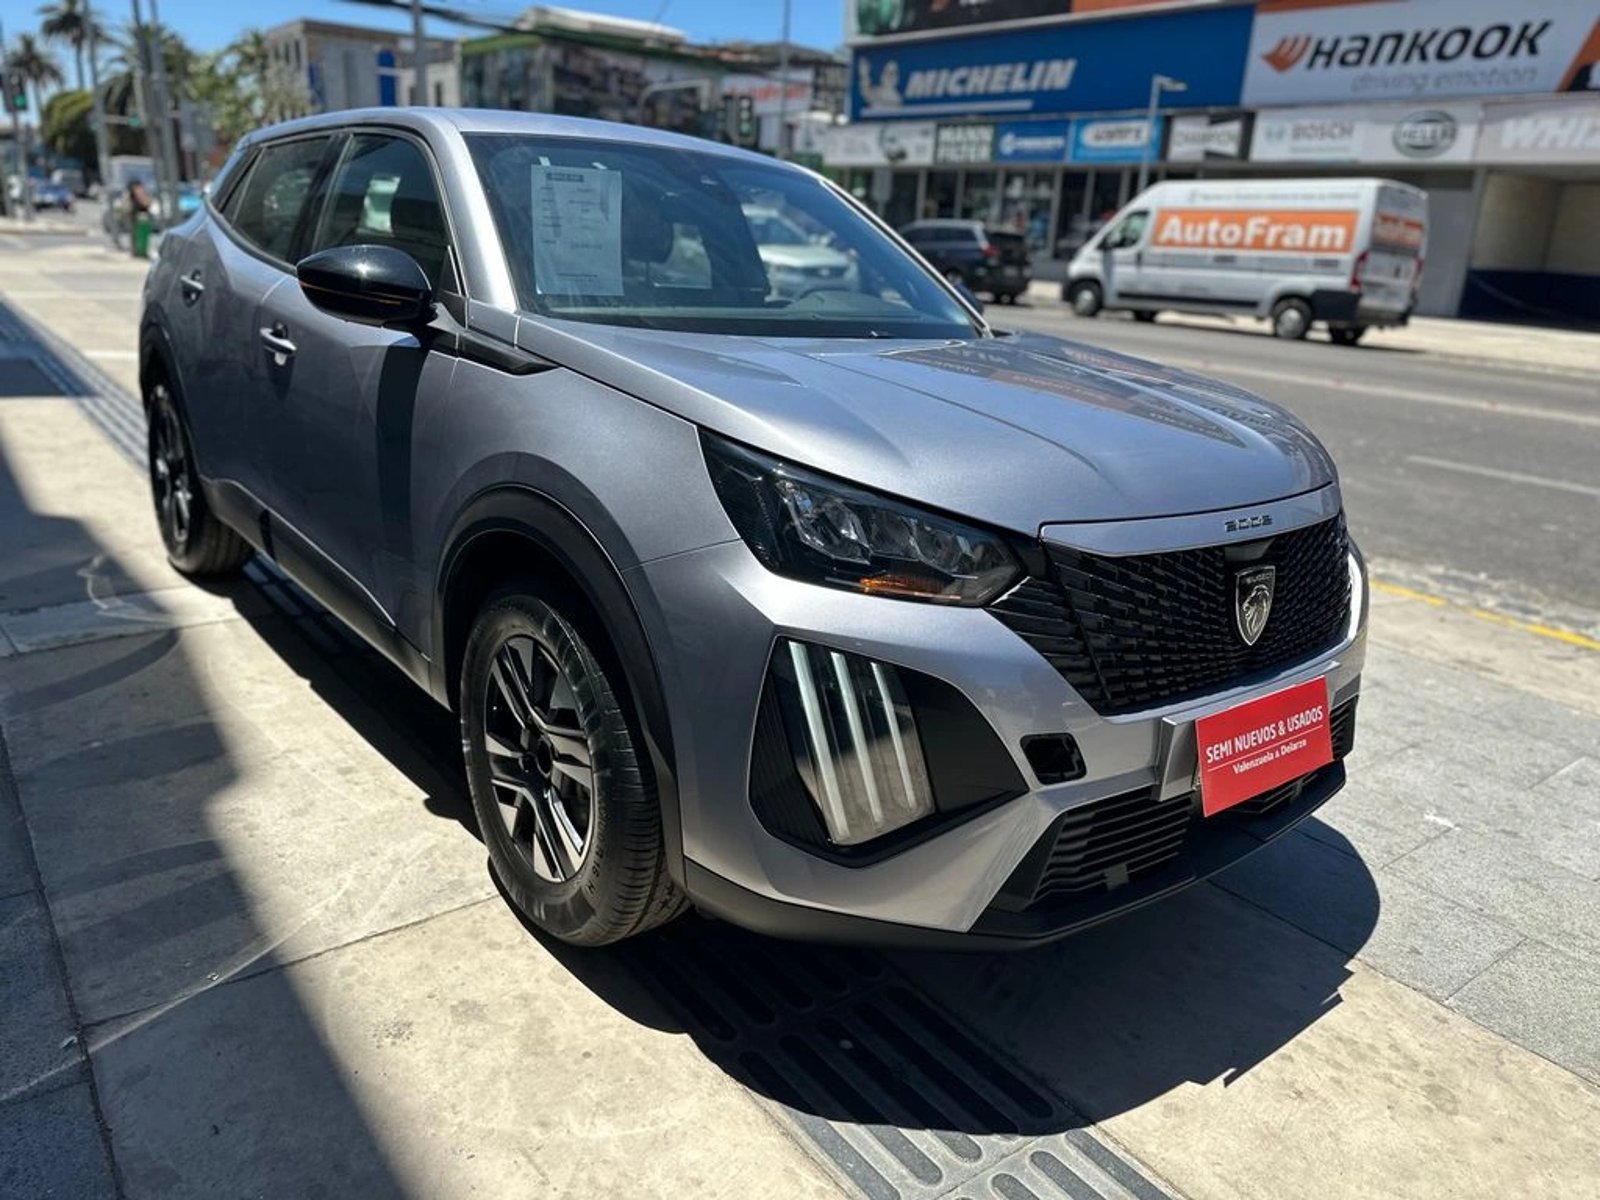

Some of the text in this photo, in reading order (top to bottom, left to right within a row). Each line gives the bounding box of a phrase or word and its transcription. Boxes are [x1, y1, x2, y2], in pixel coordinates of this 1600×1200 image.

[904, 58, 1078, 98] MICHELIN
[1352, 67, 1538, 93] driving emotion
[1292, 121, 1354, 140] BOSCH
[1159, 214, 1347, 250] AutoFram
[1206, 706, 1323, 764] SEMI NUEVOS & USADOS
[1232, 751, 1274, 774] Valenzuela
